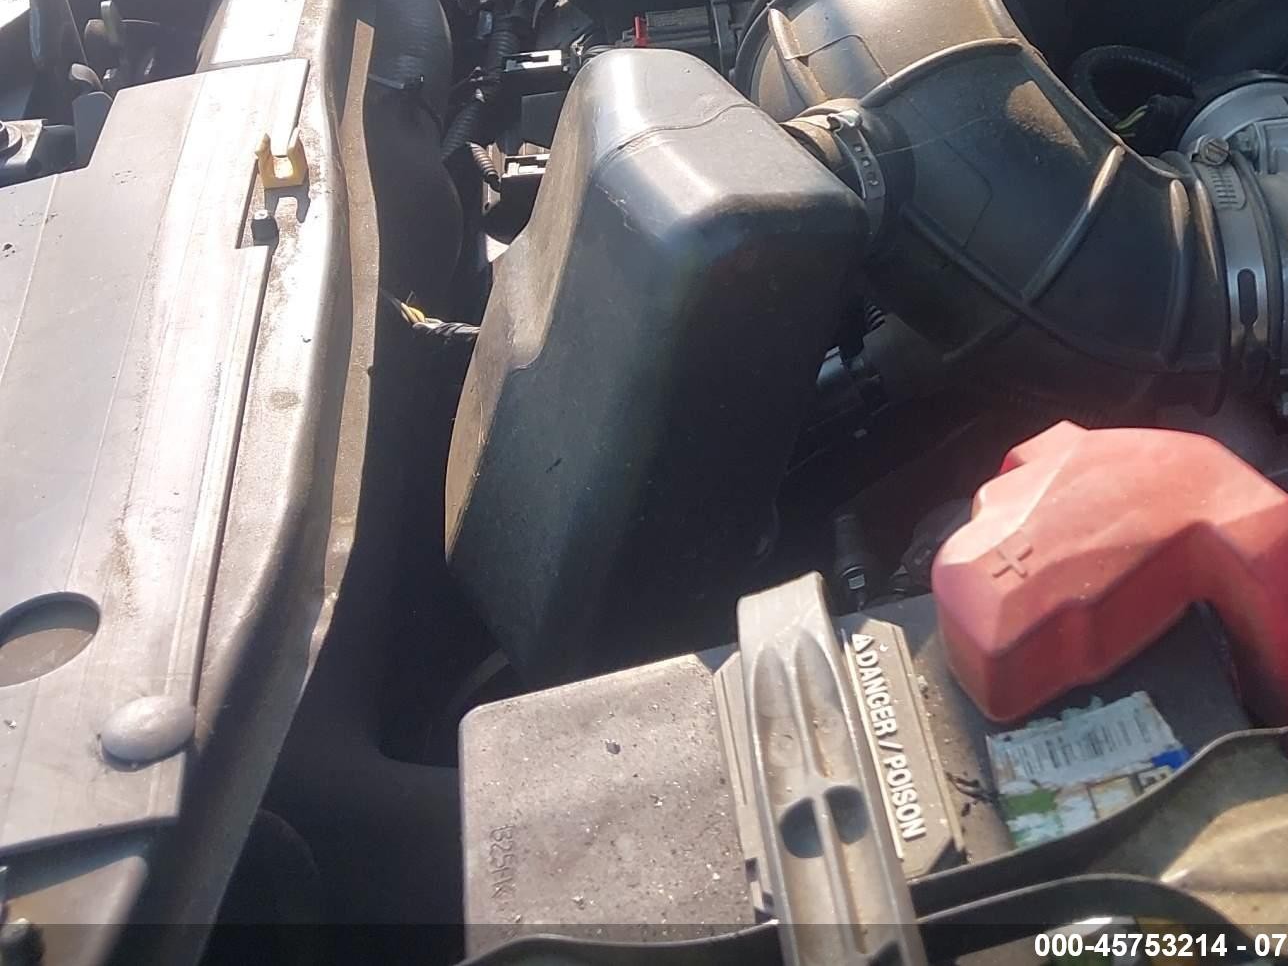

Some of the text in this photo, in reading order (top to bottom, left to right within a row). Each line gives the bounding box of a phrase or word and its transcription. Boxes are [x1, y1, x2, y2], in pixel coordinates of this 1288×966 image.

[854, 650, 928, 842] DANGER / POISON
